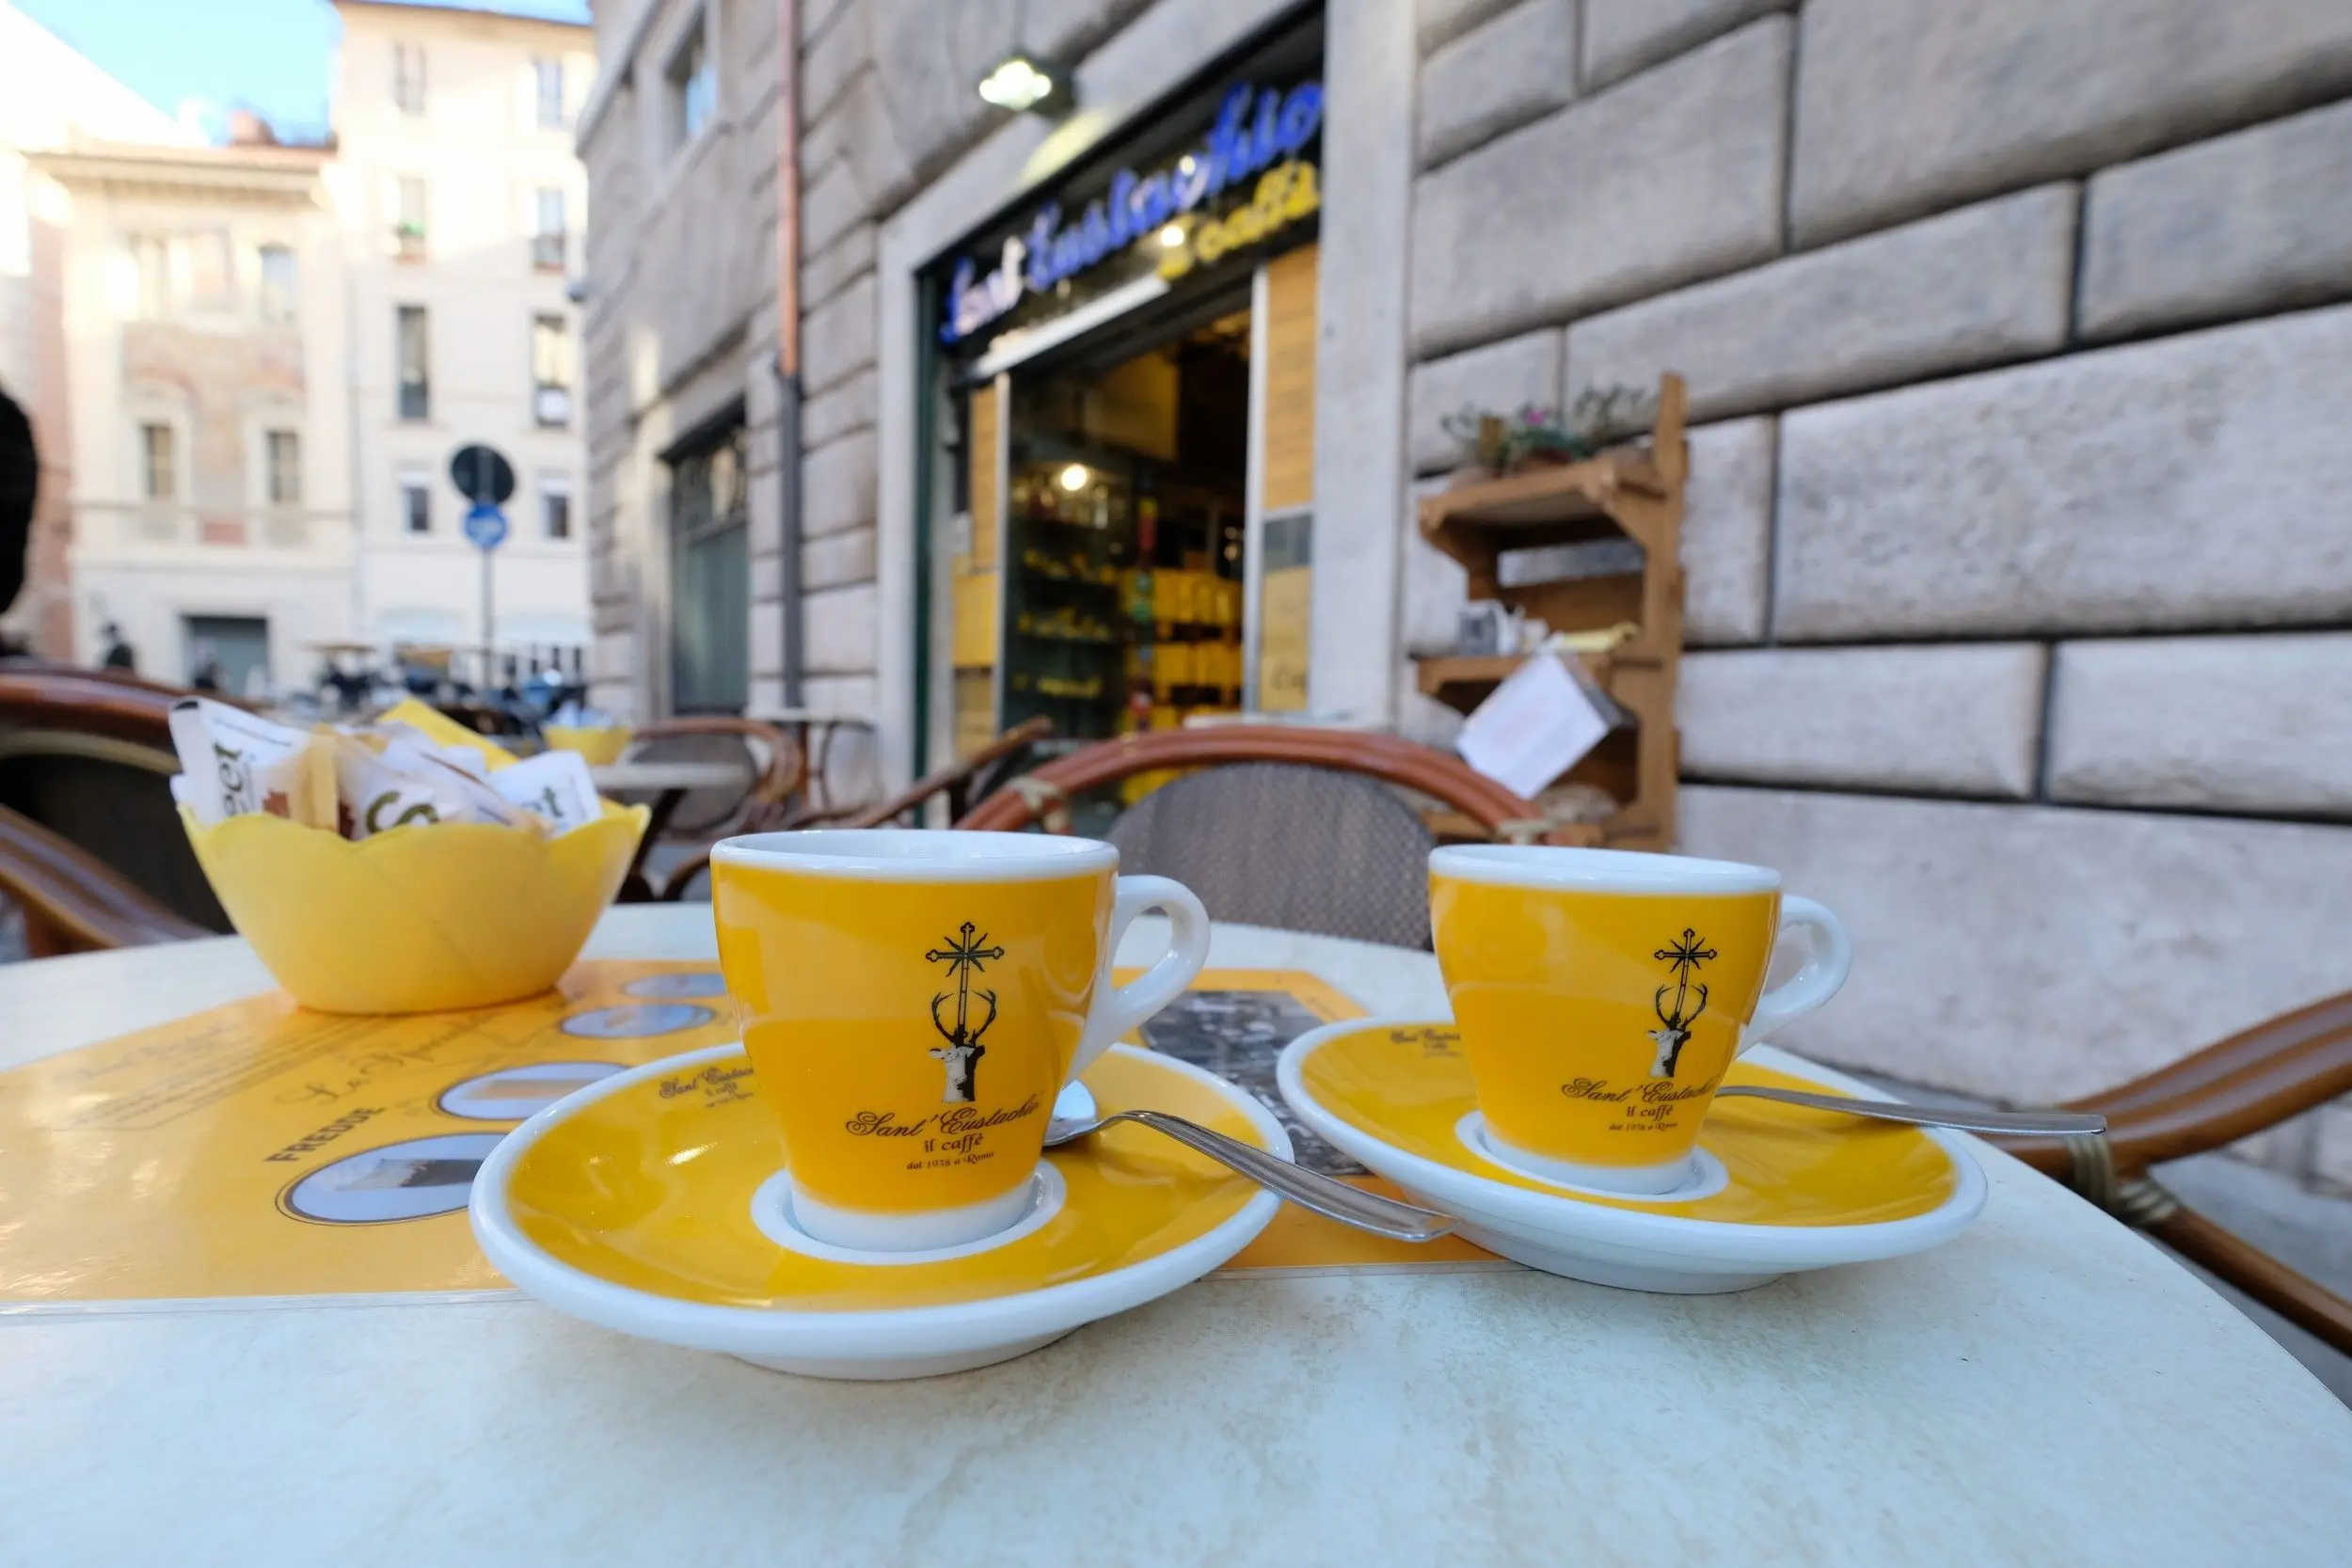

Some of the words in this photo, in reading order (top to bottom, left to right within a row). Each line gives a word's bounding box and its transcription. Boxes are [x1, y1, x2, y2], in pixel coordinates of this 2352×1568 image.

[1627, 1105, 1636, 1117] il
[924, 1139, 935, 1152] il
[942, 1132, 984, 1155] caffè
[907, 1160, 923, 1170] dal
